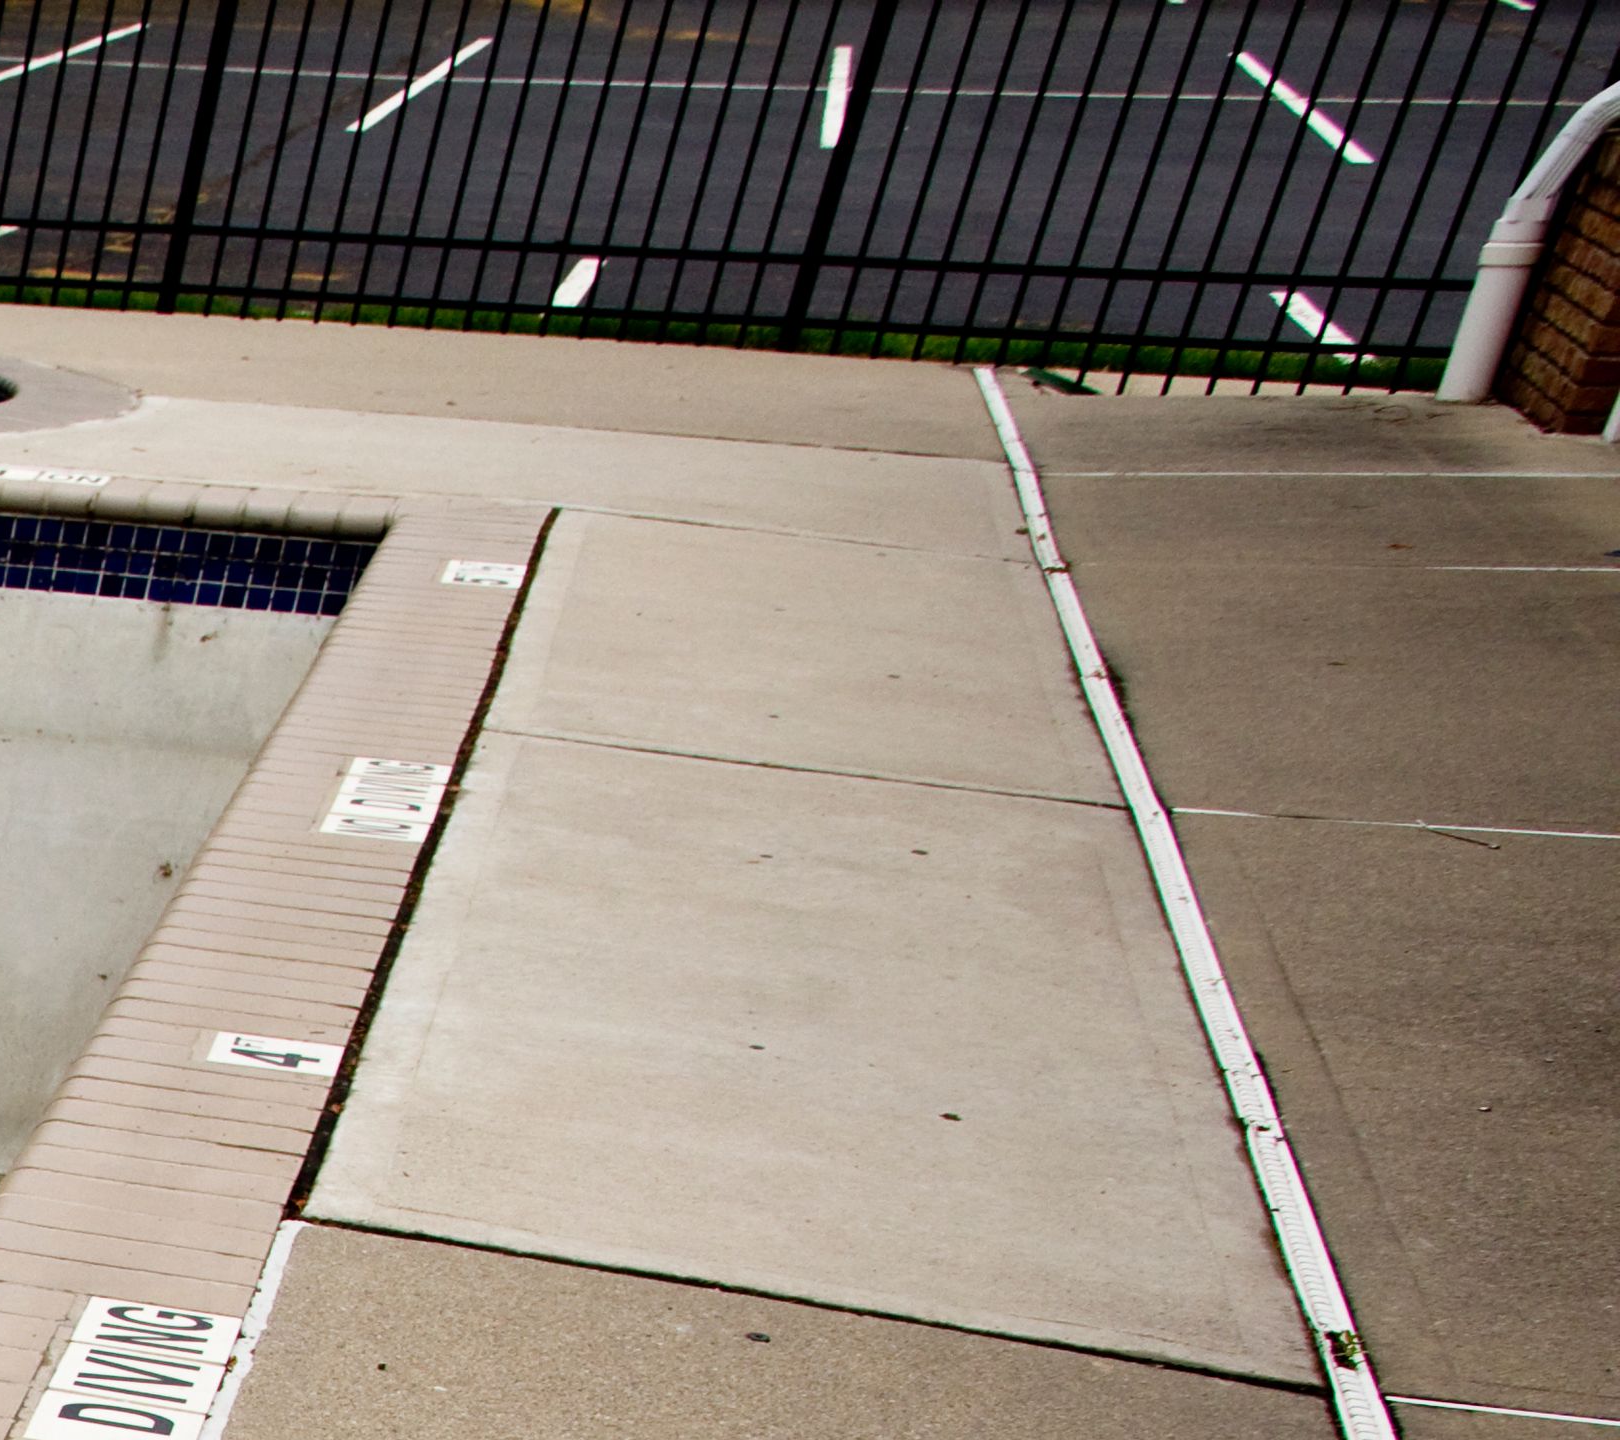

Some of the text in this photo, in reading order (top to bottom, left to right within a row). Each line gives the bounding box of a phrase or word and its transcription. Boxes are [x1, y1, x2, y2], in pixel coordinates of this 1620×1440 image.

[335, 761, 436, 839] NO DIVING
[230, 1047, 321, 1068] 4
[58, 1306, 214, 1436] DIVING
